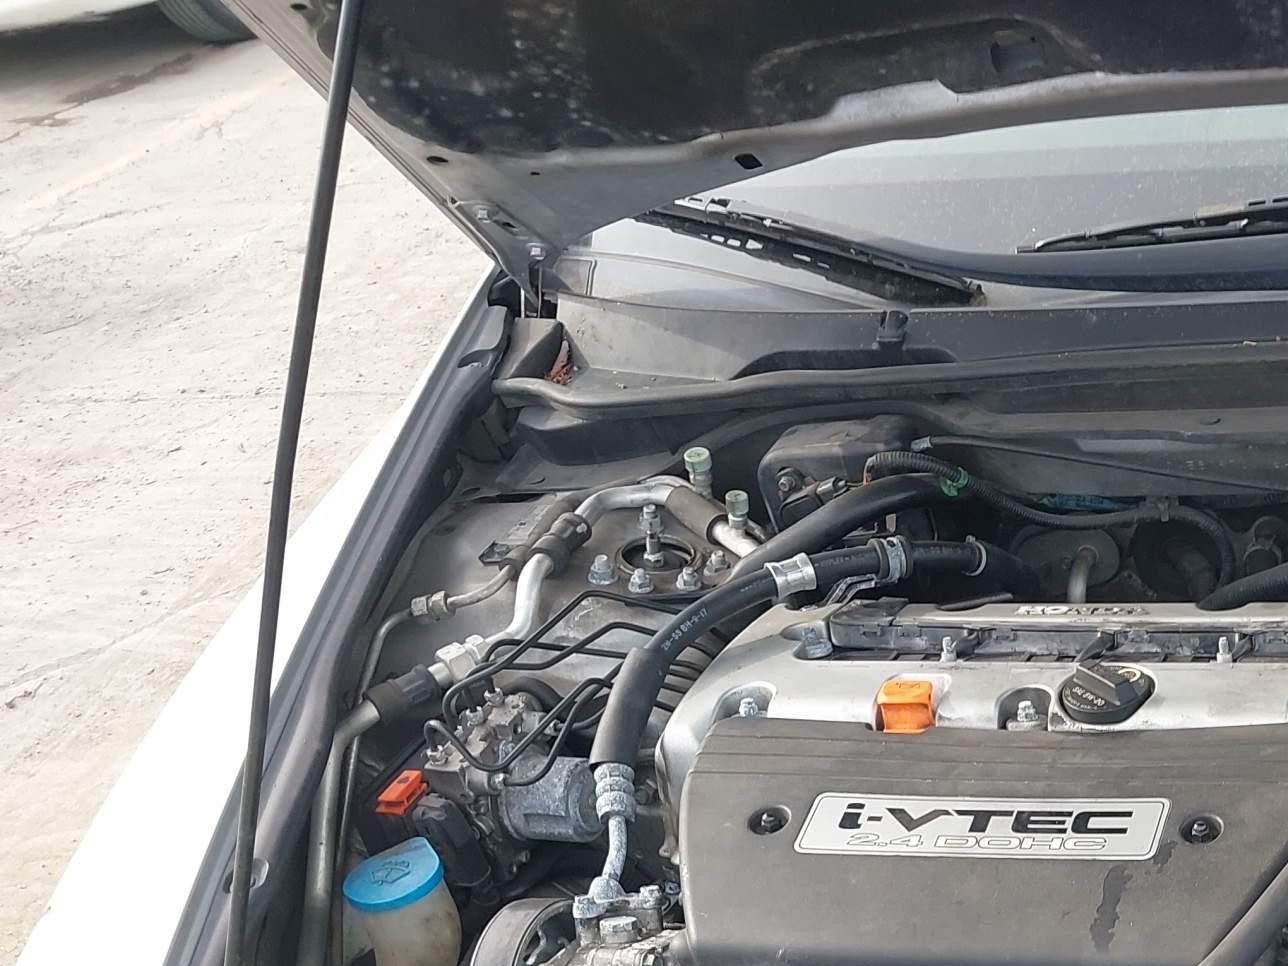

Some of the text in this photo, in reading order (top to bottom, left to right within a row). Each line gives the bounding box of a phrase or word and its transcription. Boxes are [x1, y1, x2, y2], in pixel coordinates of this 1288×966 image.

[838, 802, 1133, 834] i-VTEC
[847, 833, 1107, 850] 2.4 DOHC
